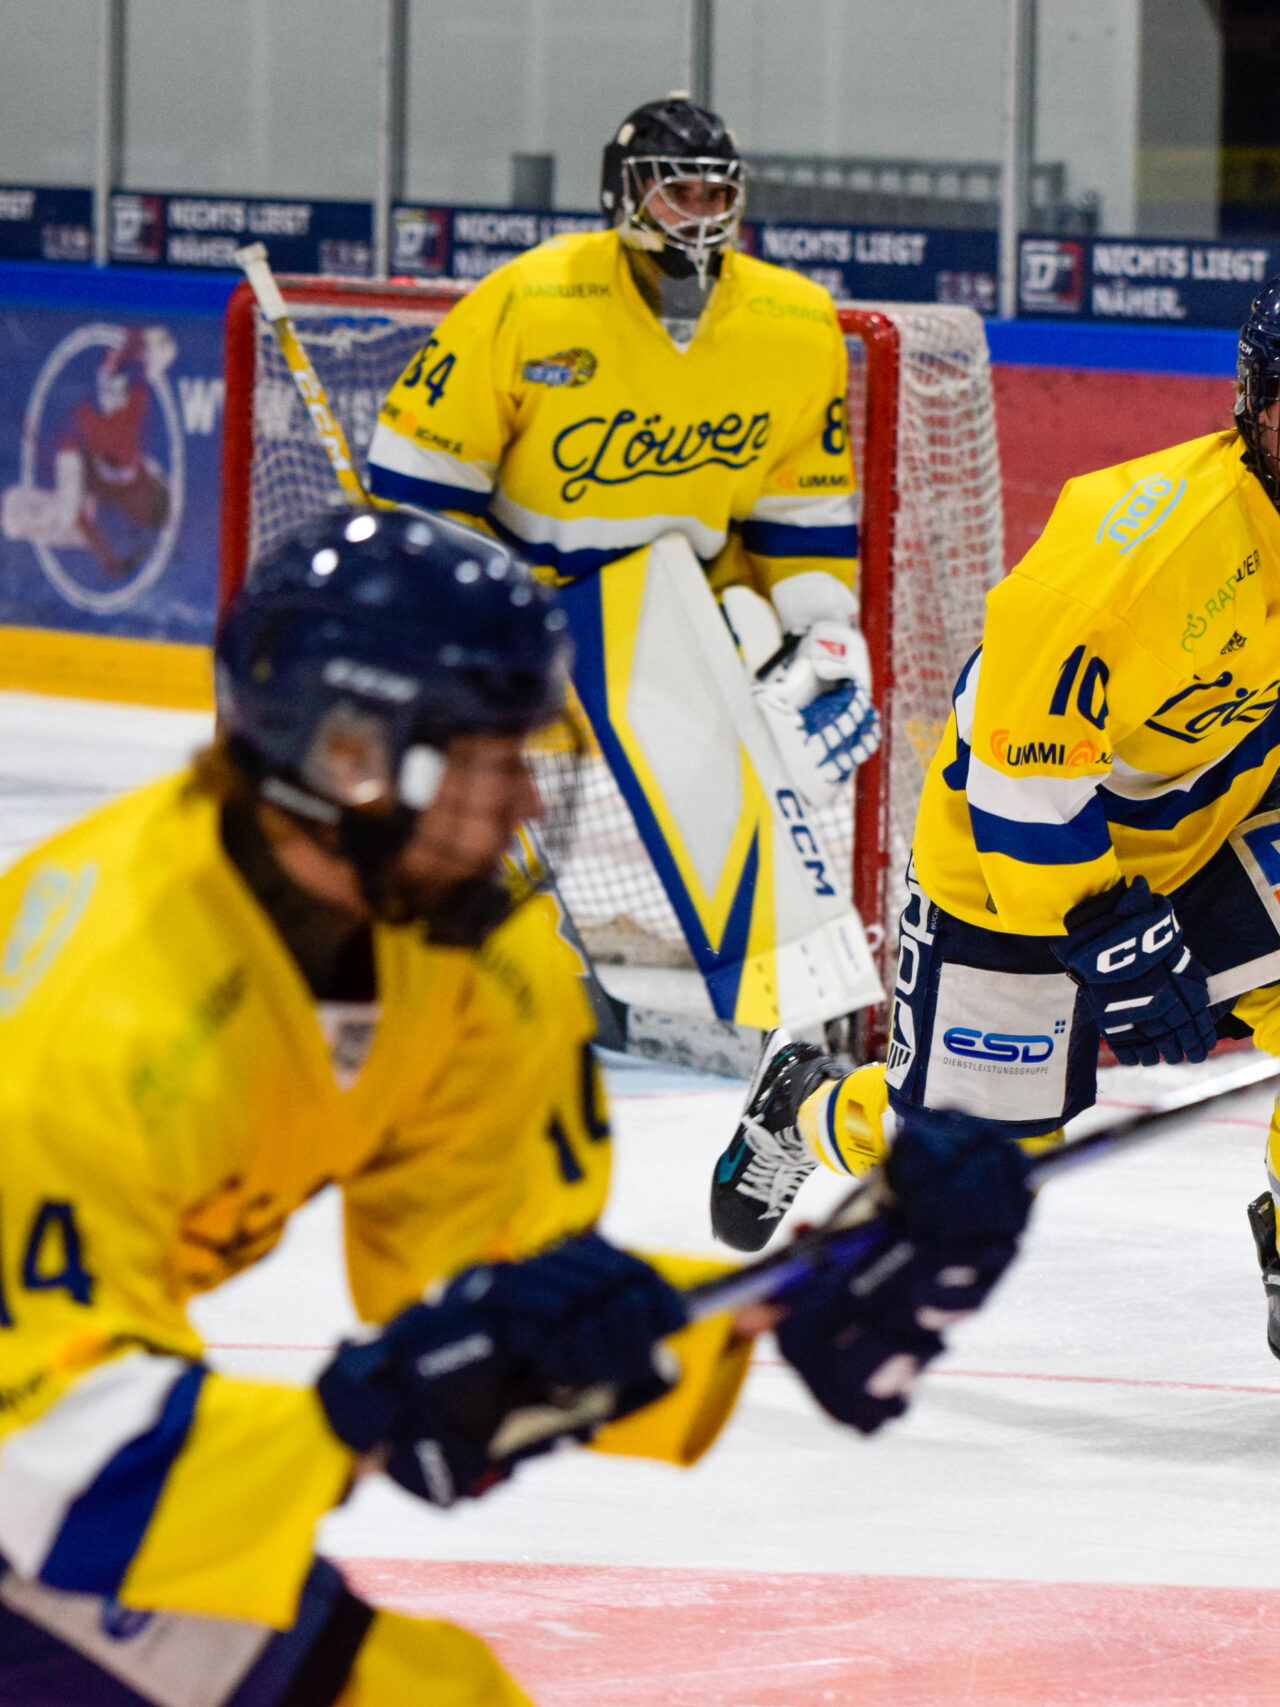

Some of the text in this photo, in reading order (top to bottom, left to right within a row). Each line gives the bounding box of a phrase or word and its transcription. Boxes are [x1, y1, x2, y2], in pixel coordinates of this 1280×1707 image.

[1092, 243, 1269, 282] NICHTS LIEGT
[552, 409, 769, 503] Löwen
[1047, 644, 1111, 731] 10
[775, 788, 836, 897] CCM
[1096, 908, 1181, 974] CC
[943, 1027, 1054, 1064] ESD
[943, 1056, 1049, 1076] DIENSTLEISTUNGSGRUPPE
